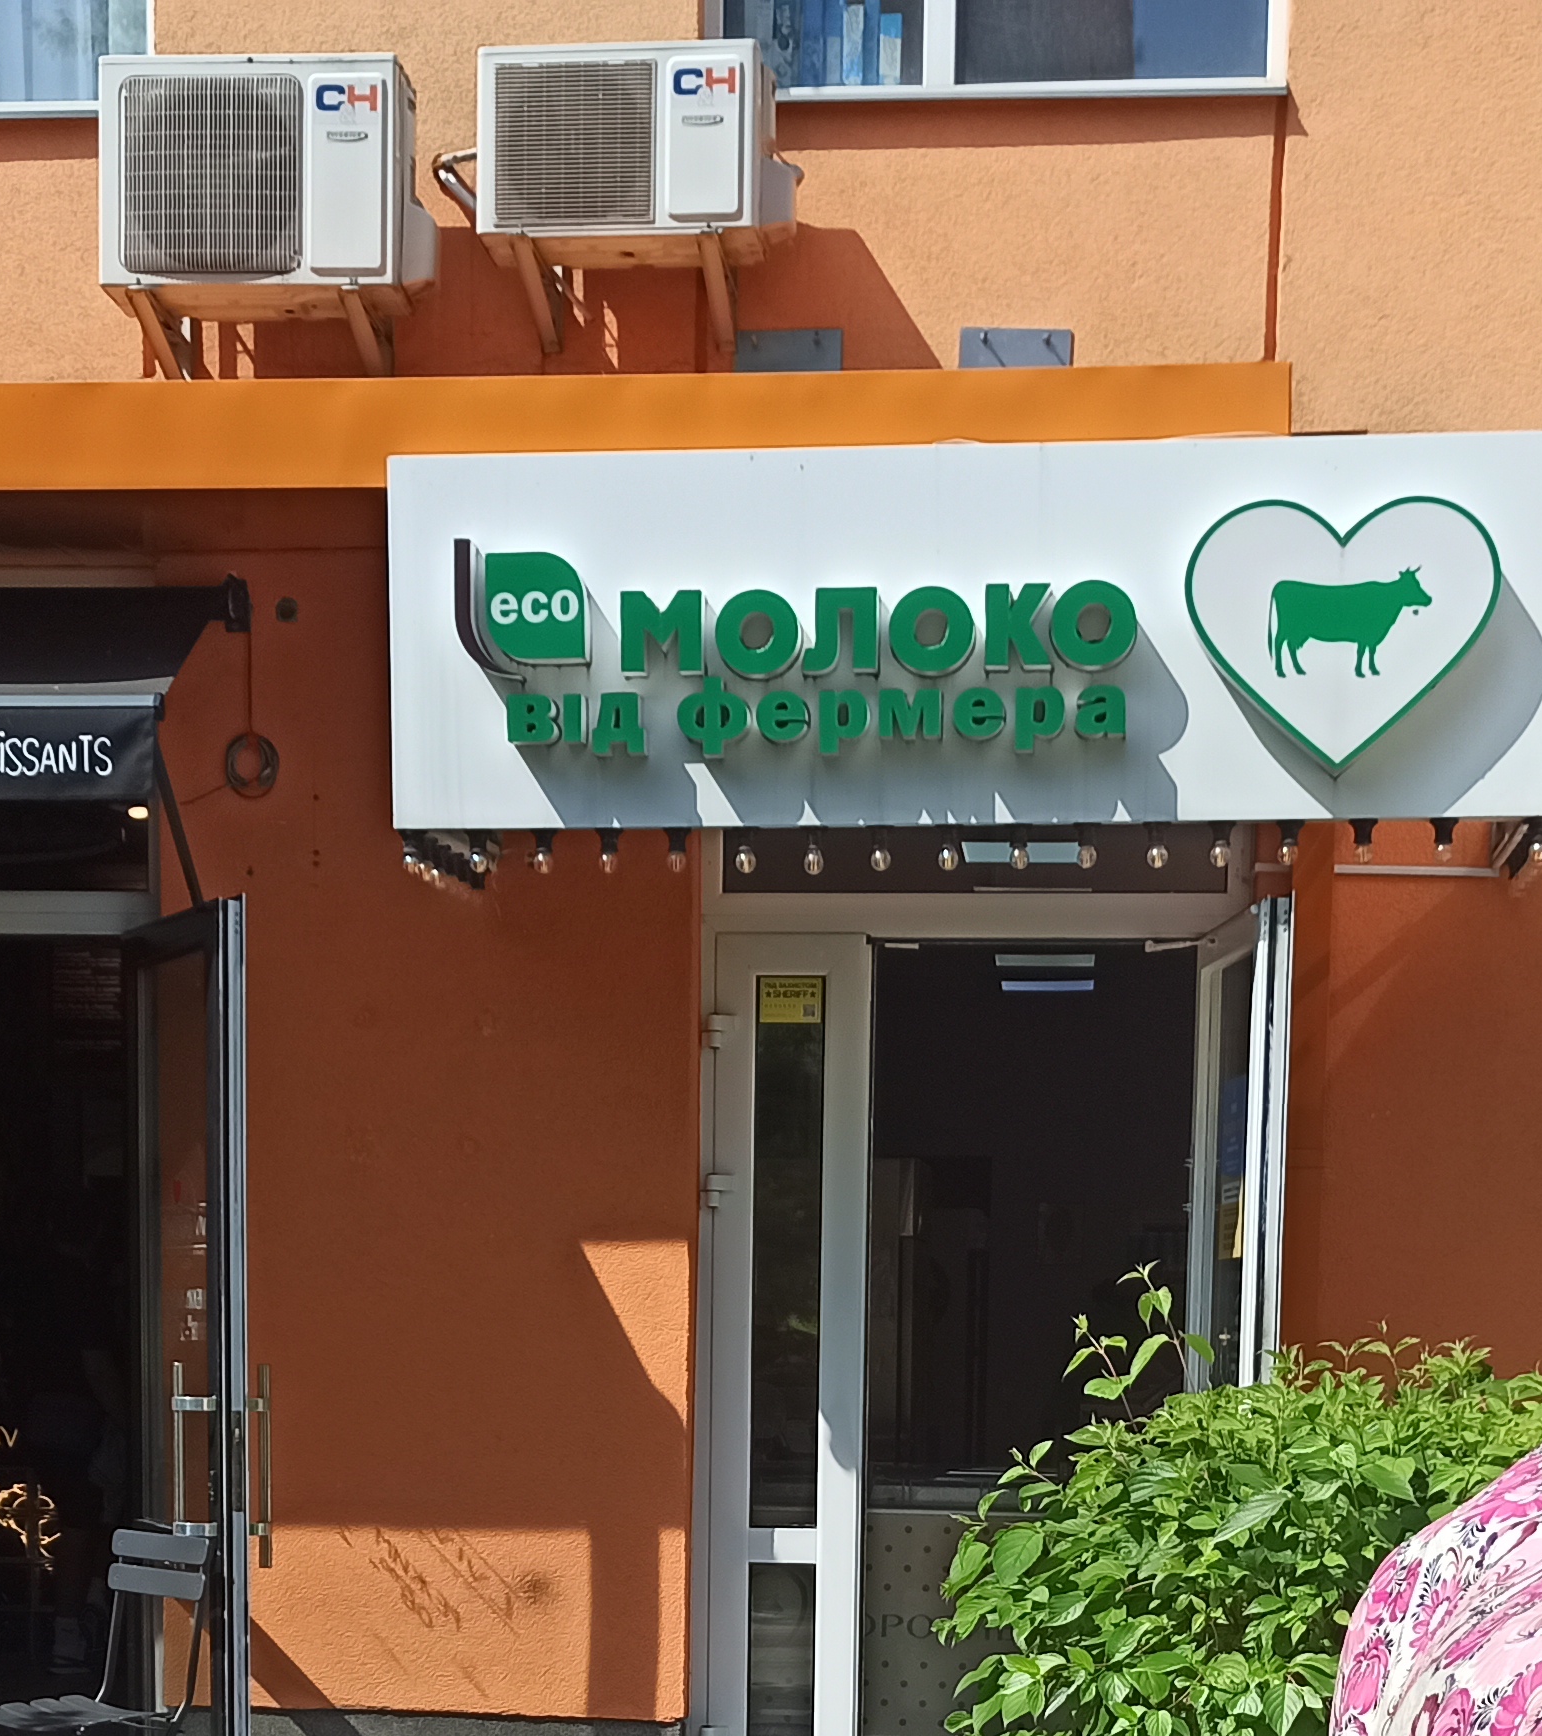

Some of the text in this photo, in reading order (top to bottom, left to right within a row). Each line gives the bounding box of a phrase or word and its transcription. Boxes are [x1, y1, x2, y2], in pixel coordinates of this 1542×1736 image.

[490, 589, 580, 625] eco
[619, 580, 1138, 679] МОЛОКО
[505, 675, 1127, 759] від фермера
